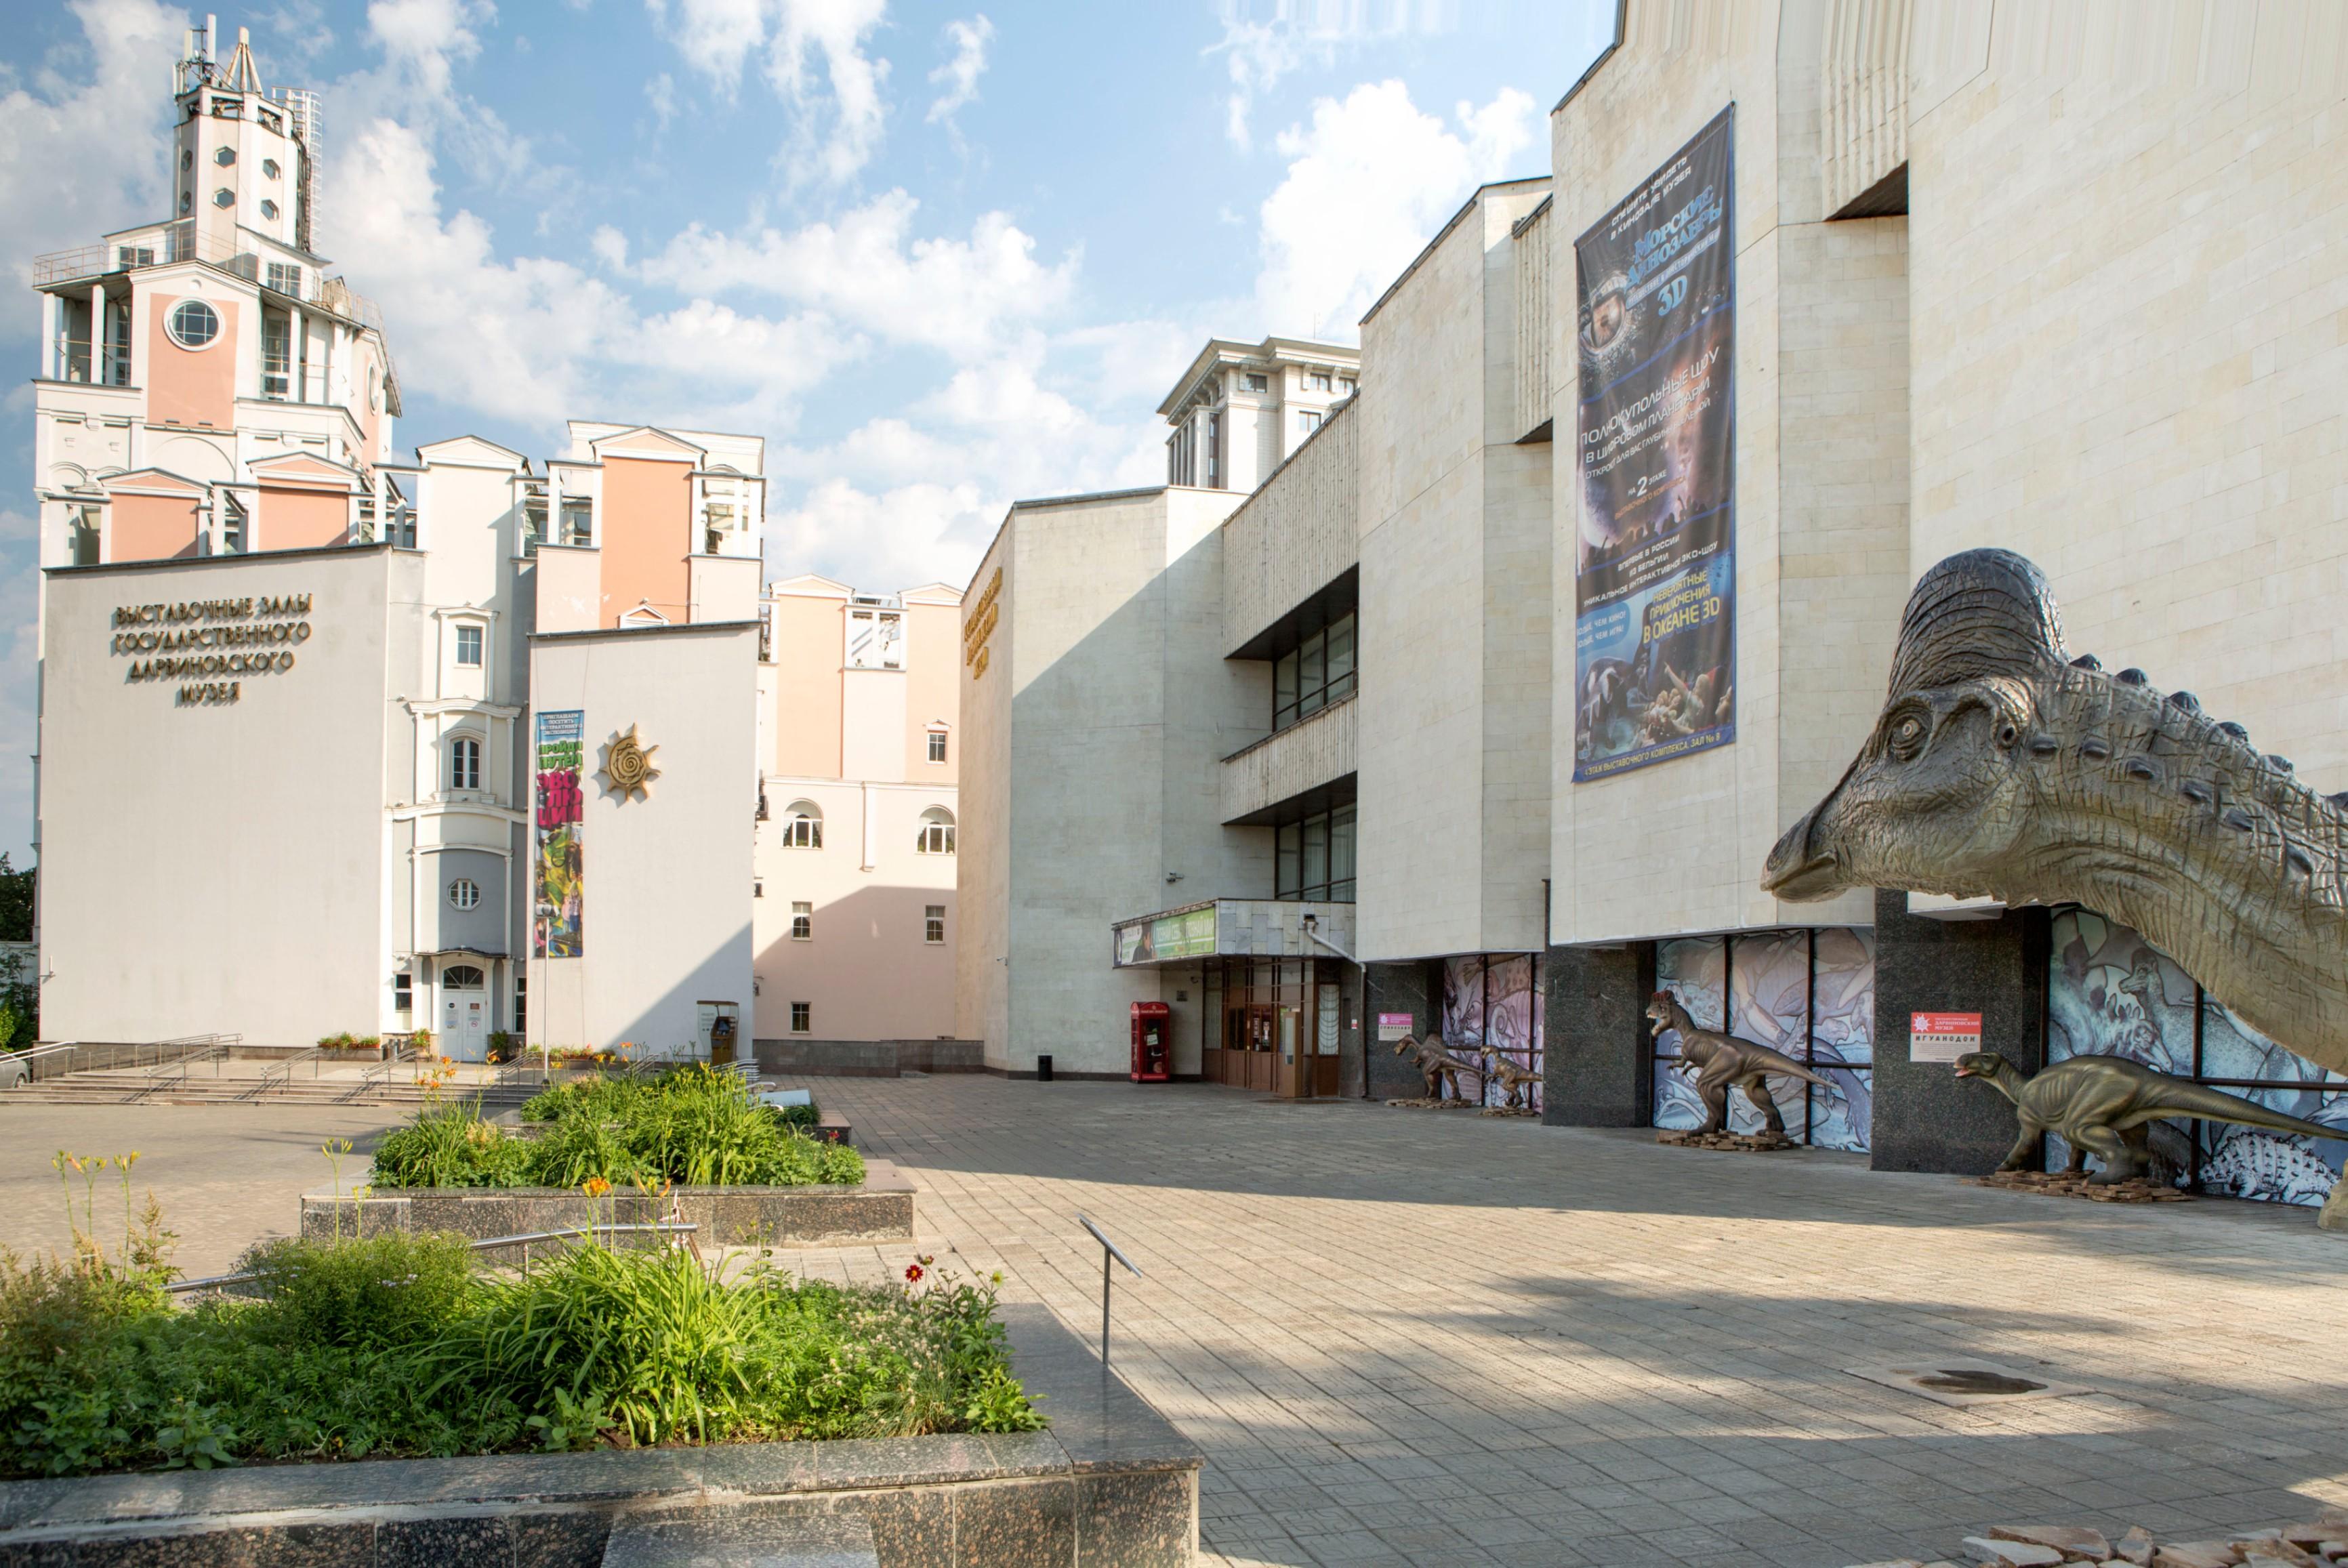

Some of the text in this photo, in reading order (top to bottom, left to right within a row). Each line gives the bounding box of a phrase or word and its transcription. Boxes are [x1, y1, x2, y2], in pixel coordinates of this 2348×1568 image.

[1611, 157, 1687, 227] СПЕШИТЕ УВИДЕТЬ
[1611, 166, 1692, 241] В КИНОЗАЛЕ МУЗЕЯ
[1634, 184, 1714, 265] МОРСКИЕ
[1624, 197, 1723, 294] ДИНОЗАВРЫ
[1657, 275, 1688, 317] 3D
[1580, 346, 1720, 445] ПОЛНОКУПОЛЬНЫЕ ШОУ
[1586, 376, 1710, 463] В ЦИФРОВОМ ПЛАНЕТАРИИ
[1616, 449, 1630, 463] ДЛЯ
[1630, 442, 1641, 456] ВАС
[1628, 469, 1667, 497] НА 2 ЭТАЖЕ
[1618, 534, 1680, 571] ВПЕРВЫЕ В РОССИИ
[1629, 552, 1669, 577] ИЗ БЕЛЬГИИ
[1584, 584, 1628, 608] УНИКАЛЬНОЕ
[1628, 557, 1681, 590] ИНТЕРАКТИВНОЕ
[1653, 570, 1708, 602] НЕВЕРОЯТНЫЕ
[116, 592, 313, 625] ВЫСТАВОЧНЫЕ ЗАЛЫ
[1594, 617, 1607, 627] ЧЕМ
[1643, 597, 1721, 644] В ОКЕАНЕ 3D
[115, 621, 311, 652] ГОСУДАРСТВЕННОГО
[1595, 630, 1608, 640] ЧЕМ
[130, 651, 295, 679] ДАРВИНОВСКОГО
[180, 681, 241, 703] МУЗЕЯ
[1603, 751, 1649, 772] ВЫСТАВОЧНОГО
[1691, 736, 1705, 748] ЗАЛ
[1715, 732, 1721, 741] 8
[1915, 1035, 1976, 1043] ИГУАНОДОН
